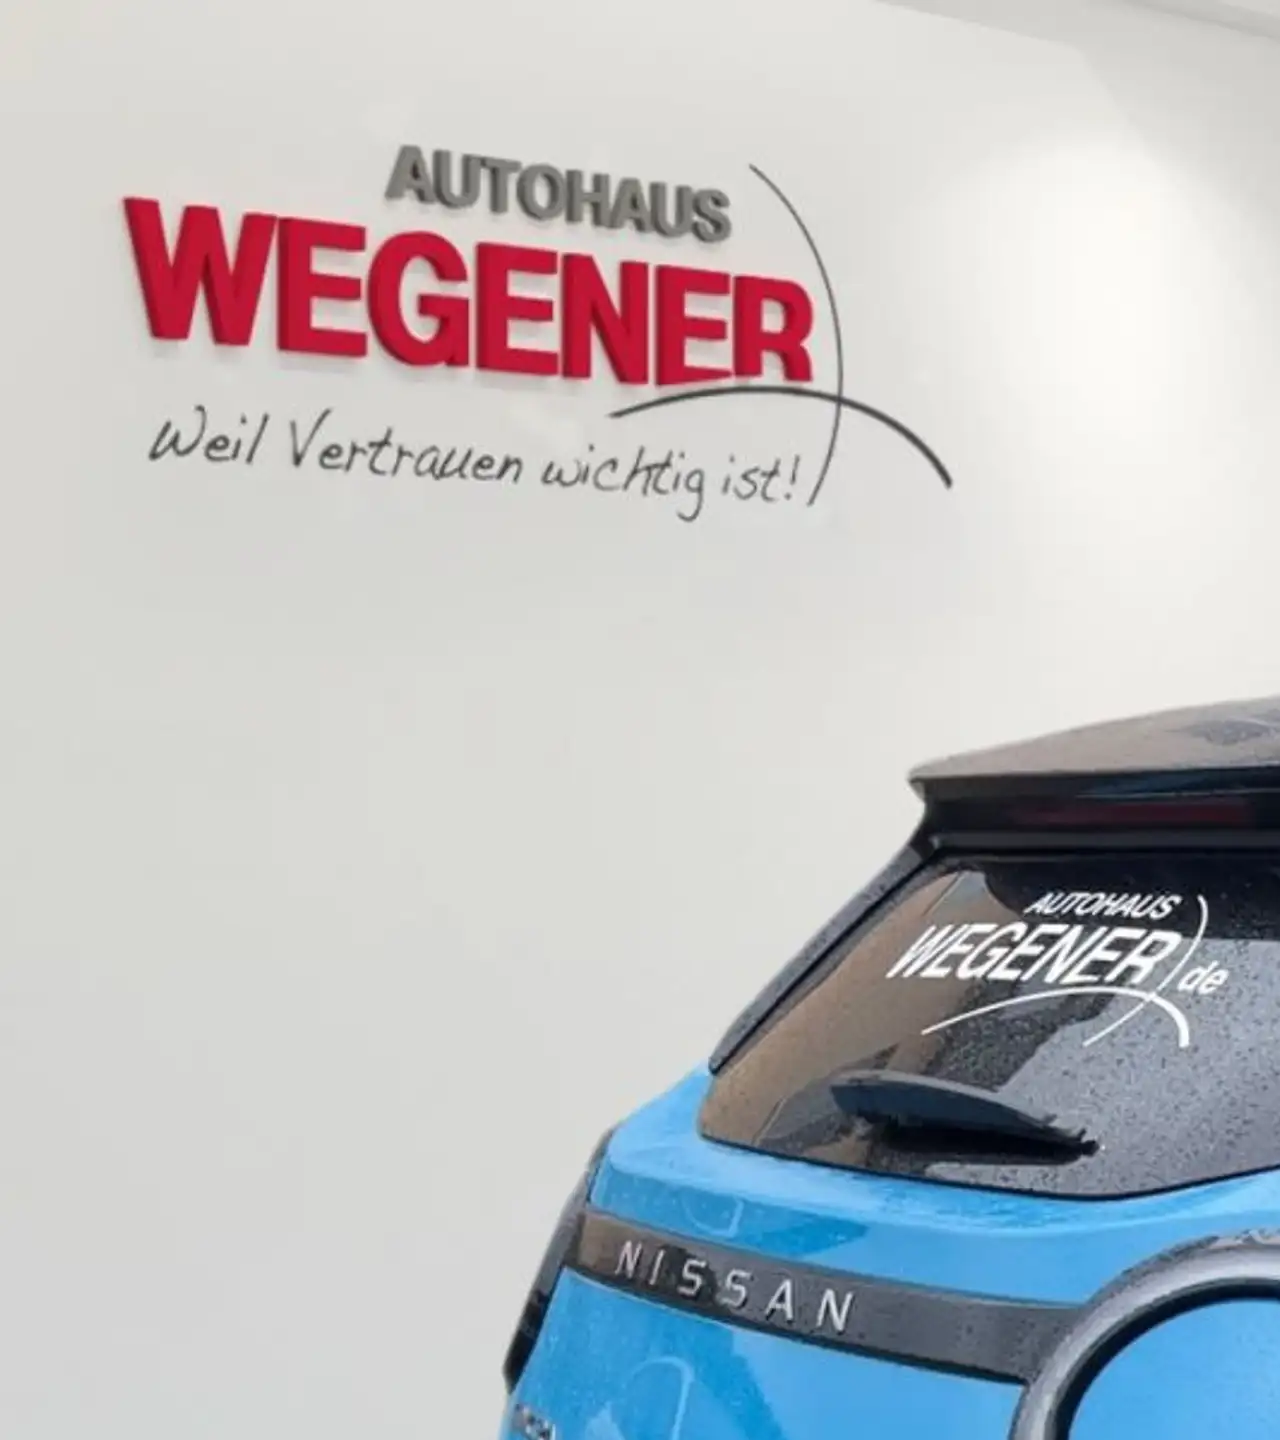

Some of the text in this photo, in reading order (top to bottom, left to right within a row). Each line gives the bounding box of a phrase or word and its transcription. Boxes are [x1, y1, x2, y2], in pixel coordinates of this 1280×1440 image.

[385, 144, 732, 243] AUTOHAUS
[124, 196, 815, 386] WEGENER
[148, 404, 801, 523] Weil Vertrauen wichtig ist!
[885, 922, 1183, 985] WEGENER
[1024, 892, 1183, 920] AUTOHAUS
[614, 1239, 856, 1333] NISSAN
